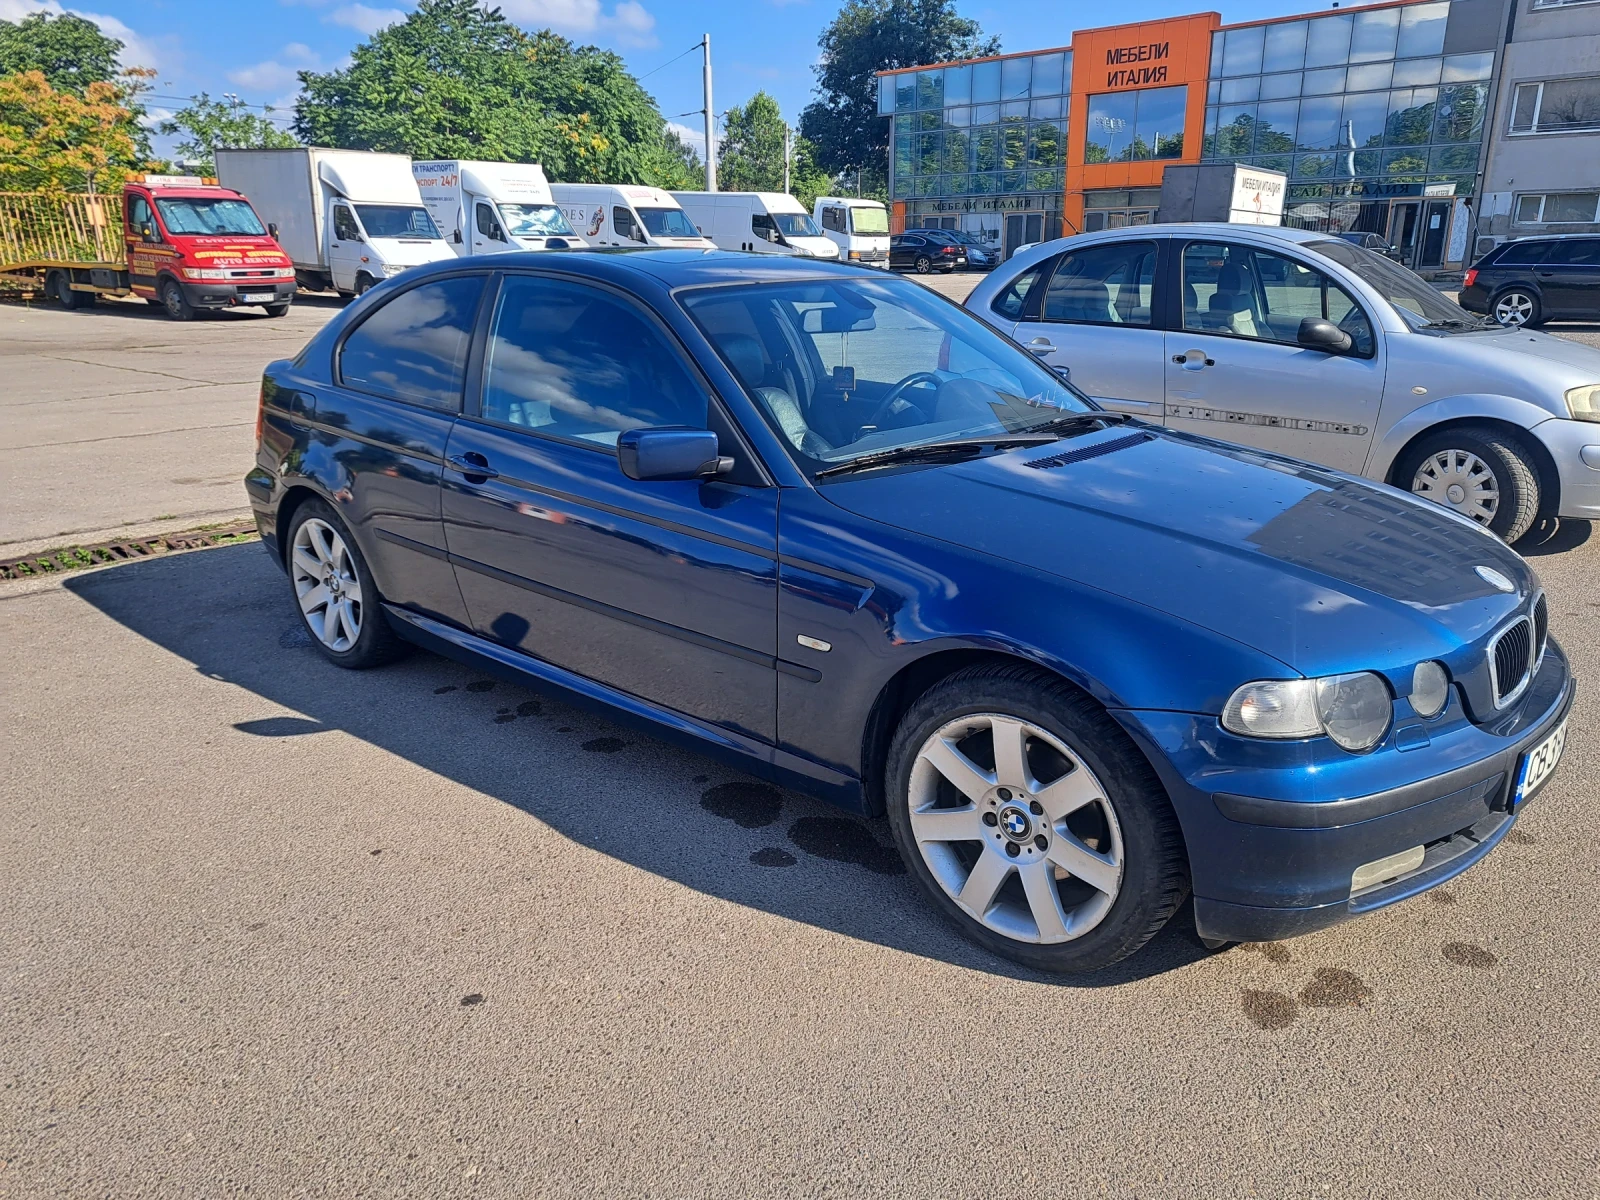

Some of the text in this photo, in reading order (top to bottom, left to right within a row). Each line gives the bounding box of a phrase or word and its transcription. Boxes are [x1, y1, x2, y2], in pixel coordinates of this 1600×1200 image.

[1106, 42, 1169, 65] МЕБЕЛИ
[1108, 66, 1167, 87] ИТАЛИЯ
[420, 164, 454, 172] ТРАНСПОРТ?
[440, 173, 458, 187] 24/7
[1242, 177, 1262, 190] МЕБЕЛИ
[1286, 184, 1410, 197] ЕЛИ ИТАЛИЯ
[932, 199, 1031, 211] МЕБЕЛИ ИТАЛИЯ
[149, 254, 172, 263] SERVICE
